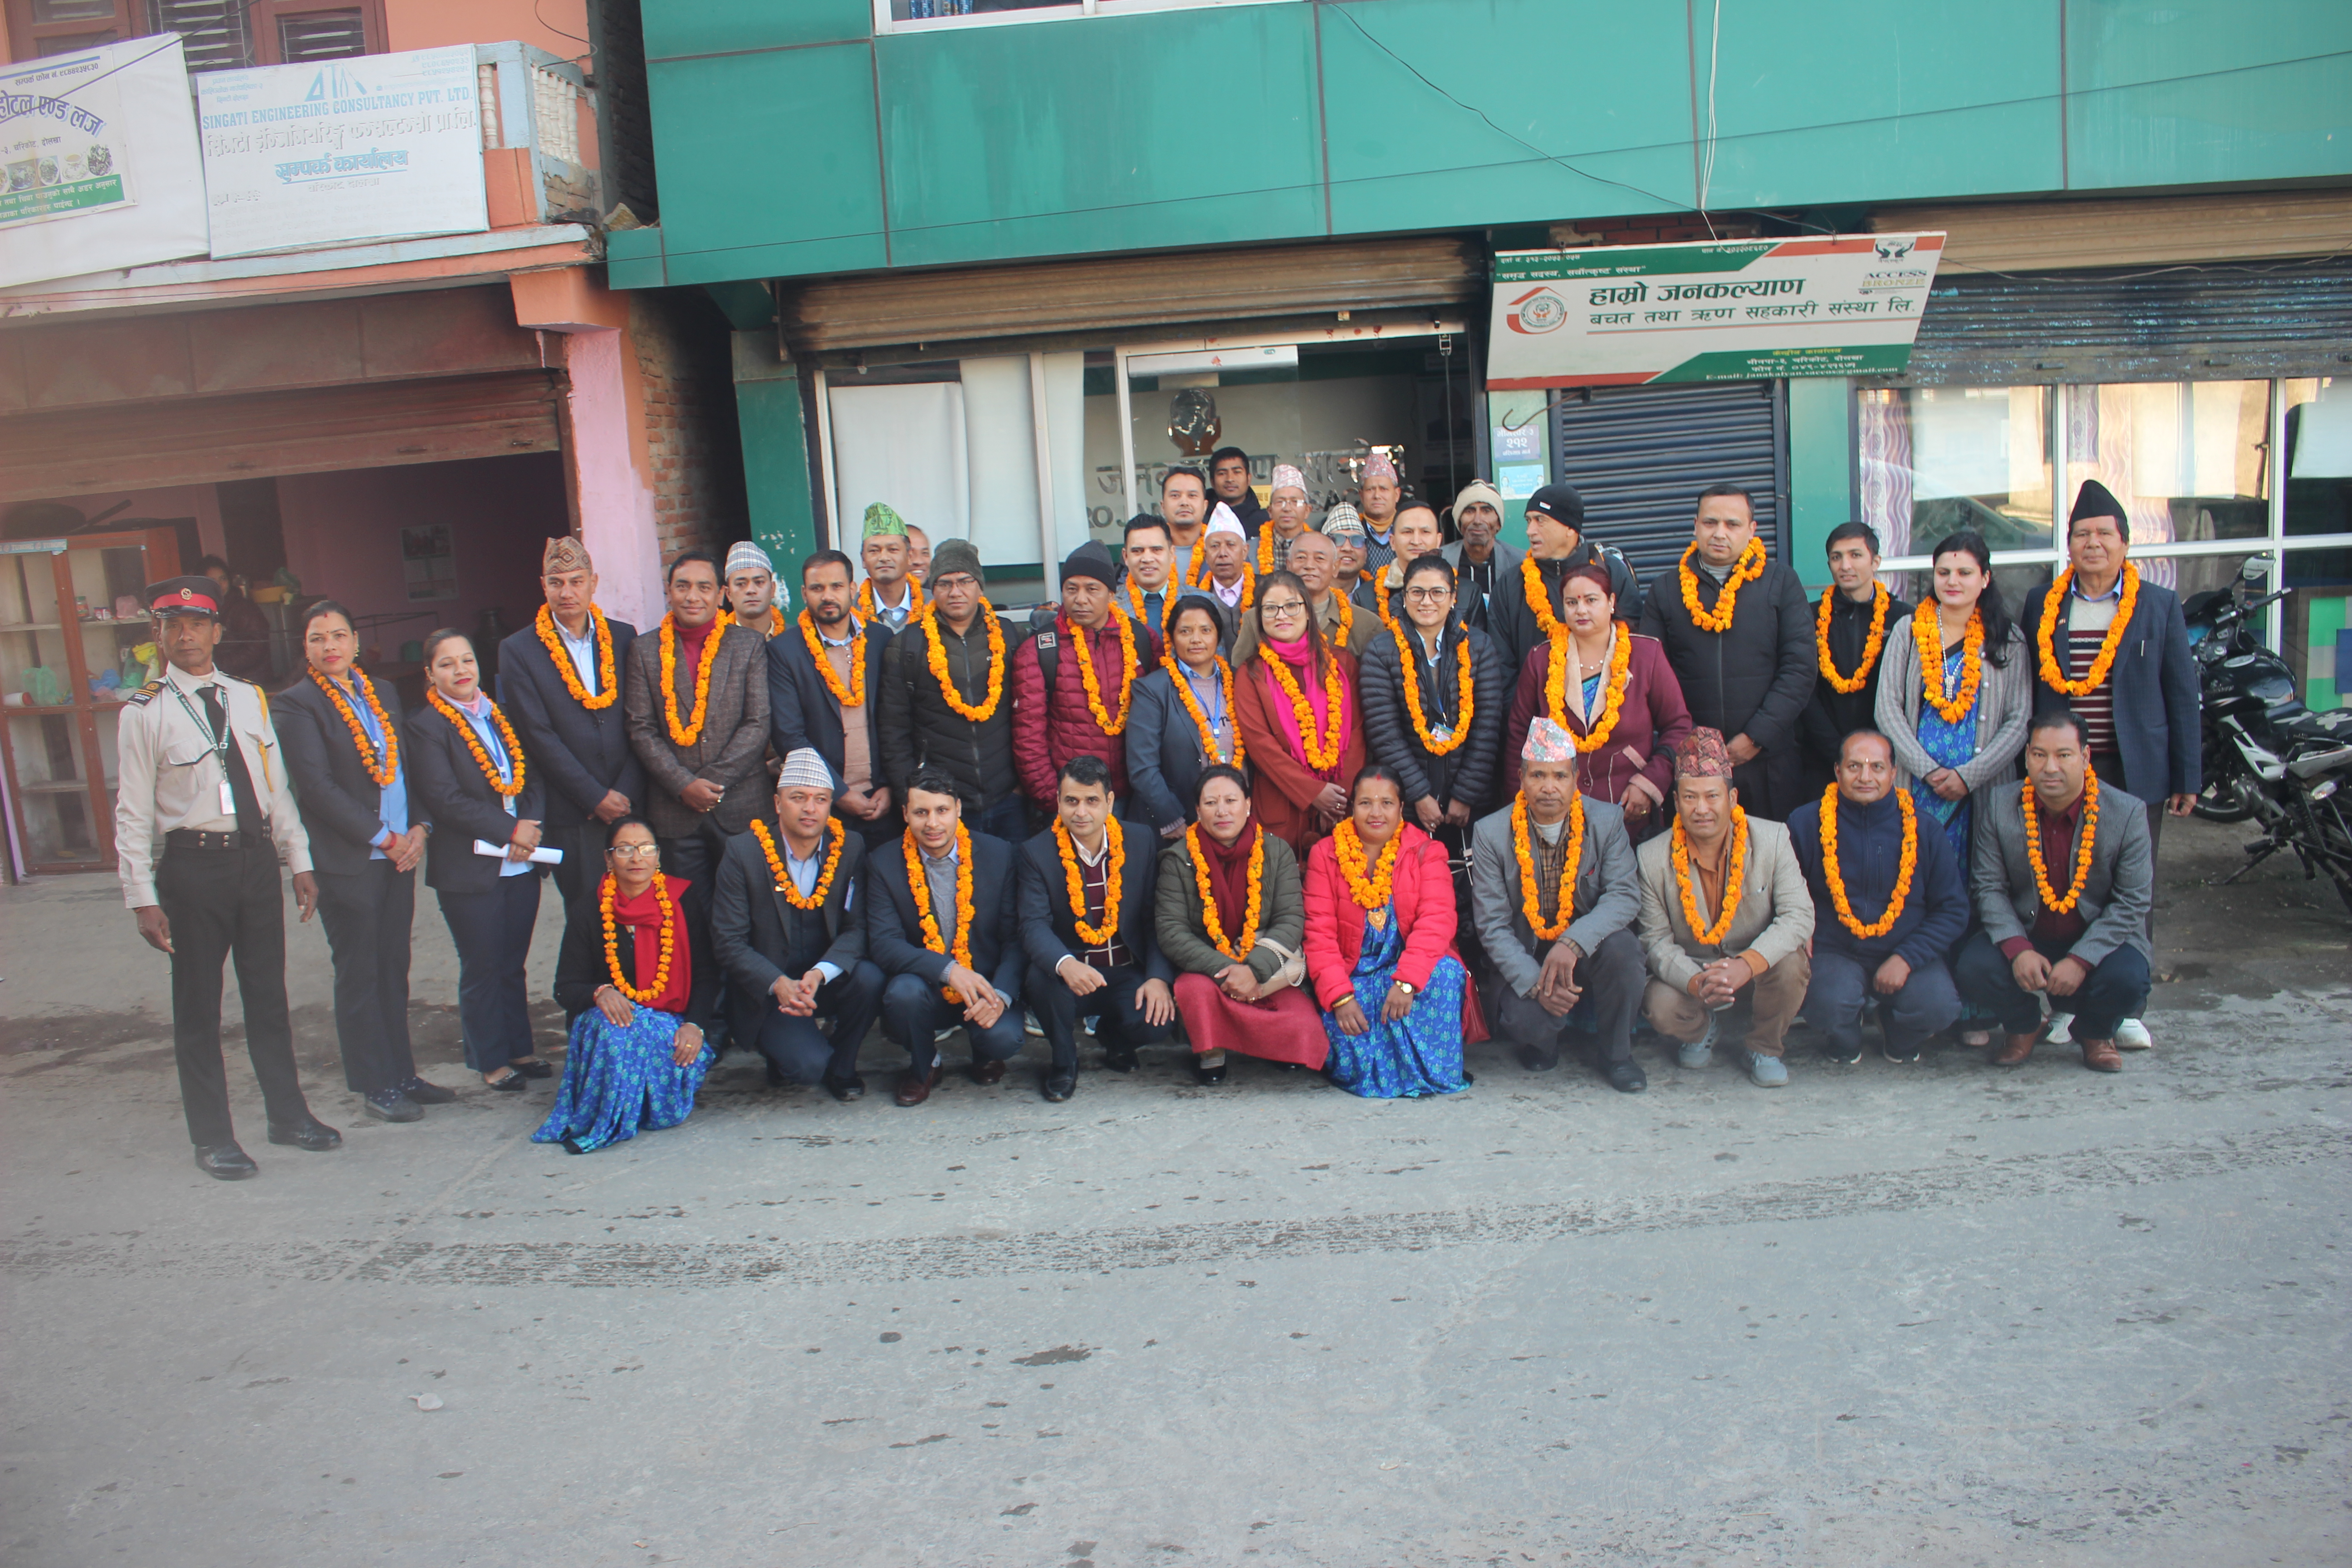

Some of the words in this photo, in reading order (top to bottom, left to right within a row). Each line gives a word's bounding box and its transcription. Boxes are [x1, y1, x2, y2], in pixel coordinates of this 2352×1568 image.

[36, 72, 50, 82] फोन
[202, 111, 249, 130] SINGATI
[252, 102, 329, 124] ENGINEERING
[332, 92, 415, 115] CONSULTANCY
[418, 89, 444, 105] PVT.
[447, 86, 474, 102] LTD.
[70, 106, 106, 137] लज
[42, 137, 62, 147] दोलखा
[274, 152, 333, 182] सम्पर्क
[333, 147, 410, 173] कार्यालय
[1865, 270, 1928, 279] ACCESS
[1862, 278, 1926, 288] BRONZE
[1588, 281, 1650, 307] हाम्रो
[1657, 277, 1806, 304] जनकल्याण
[1590, 310, 1632, 326] बचत
[1643, 309, 1681, 324] तथा
[1691, 306, 1736, 323] ऋण
[1745, 299, 1820, 320] सहकारी
[1828, 298, 1880, 317] संस्था
[1887, 295, 1916, 314] लि.
[1506, 437, 1528, 448] २१२
[11, 542, 34, 553] TUBORG
